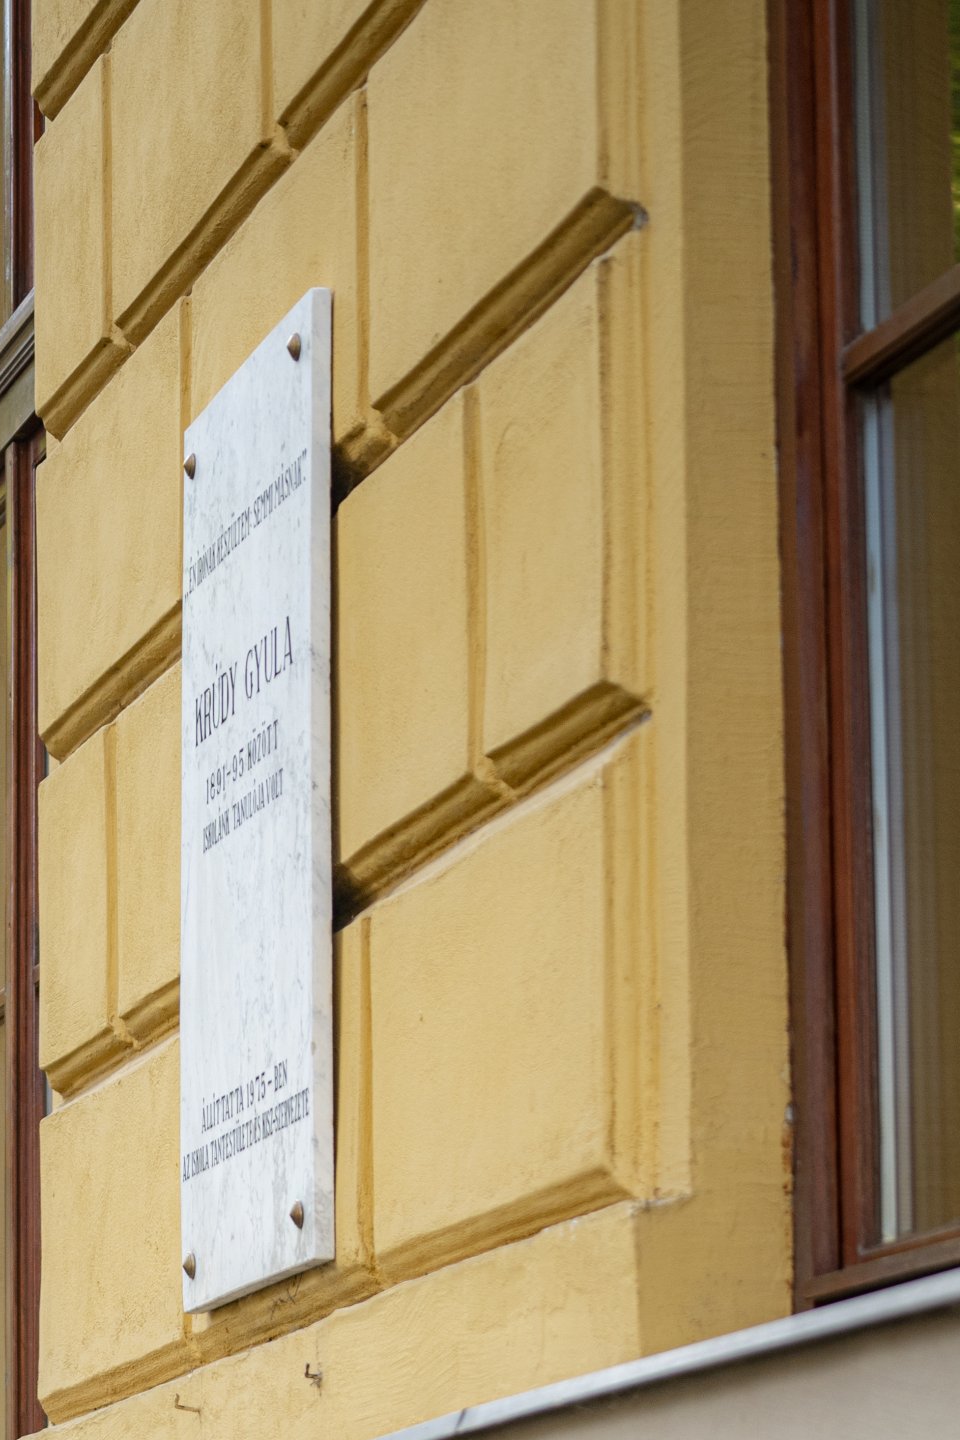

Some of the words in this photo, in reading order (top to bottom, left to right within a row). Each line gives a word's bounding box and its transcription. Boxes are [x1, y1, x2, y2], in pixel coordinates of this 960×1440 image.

[253, 484, 274, 528] SEMMI
[195, 663, 238, 747] KRÚDY
[244, 616, 293, 699] GYULA
[206, 748, 244, 804] 1891-95
[247, 719, 279, 771] KÖZÖTT
[232, 779, 265, 831] TANULÓJA
[266, 768, 284, 805] VOLT
[183, 1153, 191, 1182] AZ
[191, 1144, 210, 1177] ISKOLA
